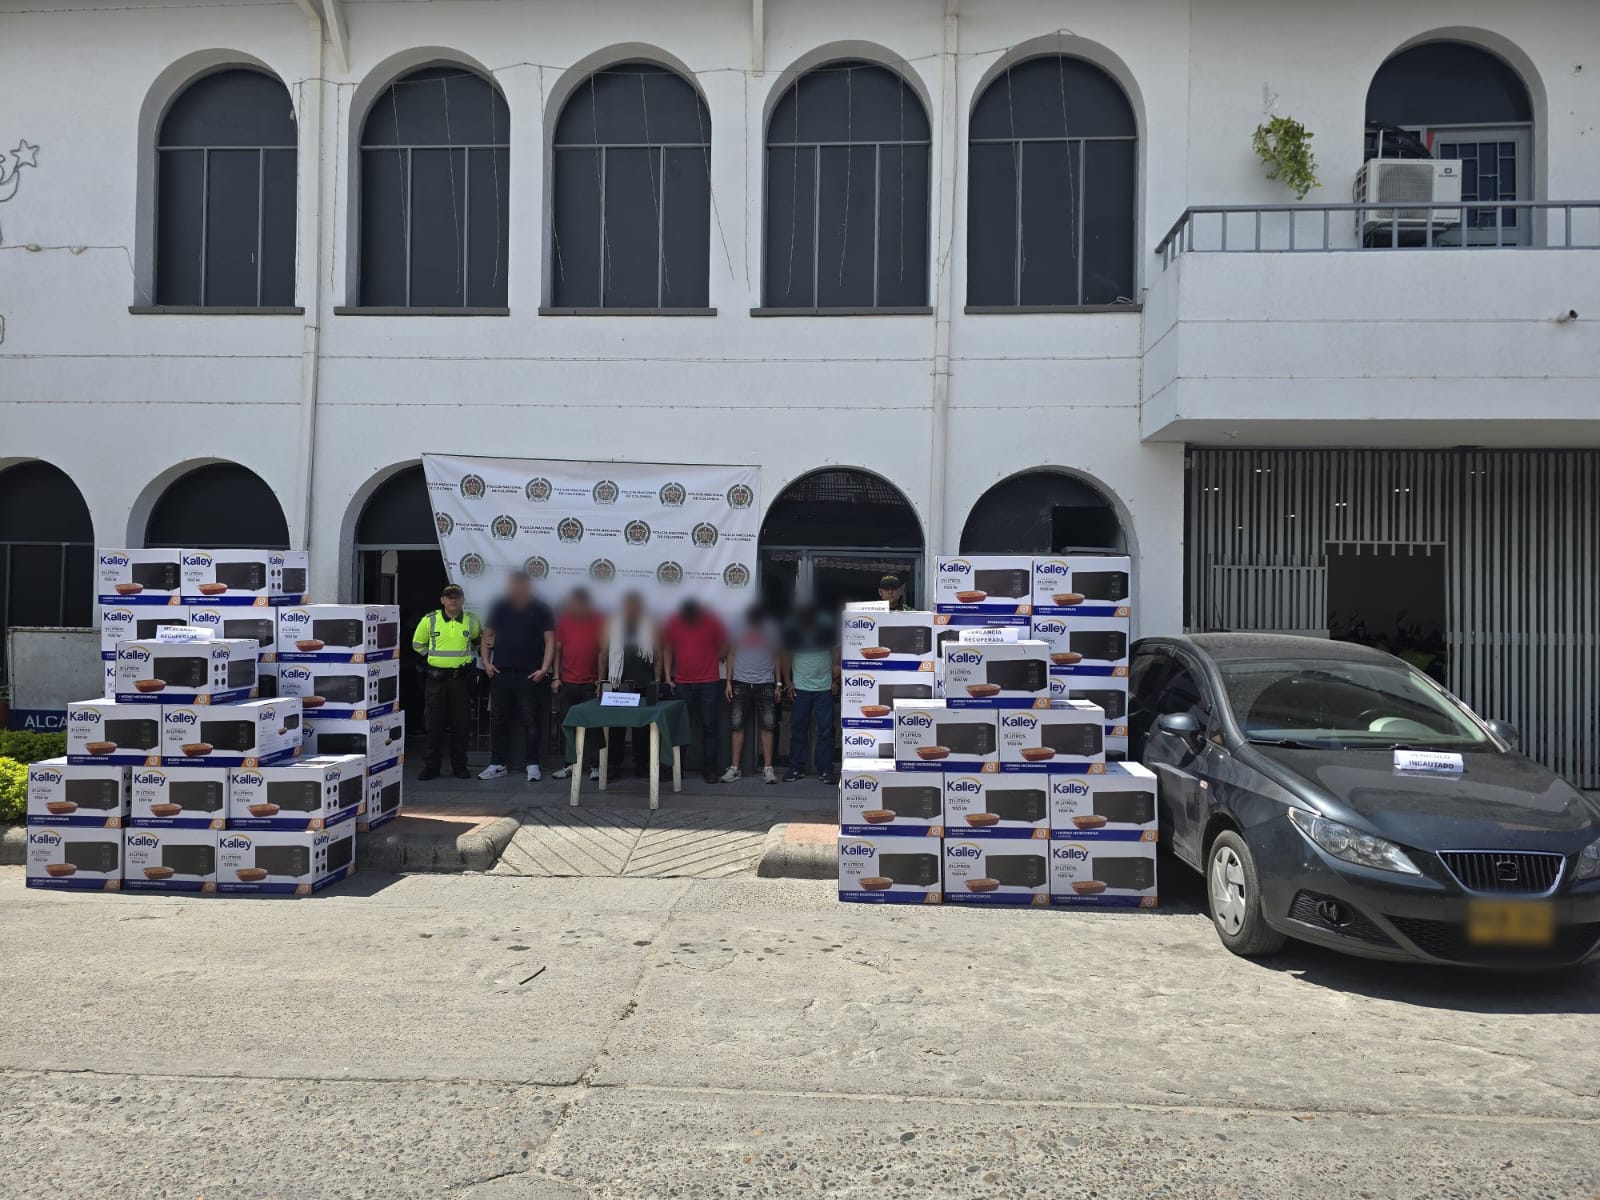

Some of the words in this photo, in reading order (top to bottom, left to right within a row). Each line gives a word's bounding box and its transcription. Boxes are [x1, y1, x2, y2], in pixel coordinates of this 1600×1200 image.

[101, 556, 129, 567] Kalley
[183, 557, 212, 567] Kalley
[269, 557, 284, 566] Kalley
[940, 563, 971, 574] Kalley
[1036, 565, 1069, 576] Kalley
[104, 612, 133, 623] Kalley
[192, 613, 220, 624] Kalley
[281, 613, 310, 624] Kalley
[366, 613, 379, 622] Kalley
[845, 620, 875, 631] Kalley
[1034, 623, 1066, 635] Kalley
[118, 650, 150, 662] Kalley
[212, 650, 230, 659] Kalley
[948, 653, 983, 665] Kalley
[281, 670, 310, 680] Kalley
[368, 669, 380, 677] Kalley
[845, 678, 875, 688] Kalley
[24, 714, 68, 728] ALCA
[70, 712, 101, 723] Kalley
[165, 713, 197, 725] Kalley
[260, 711, 275, 720] Kalley
[899, 716, 933, 728] Kalley
[1002, 717, 1037, 729] Kalley
[370, 725, 383, 734] Kalley
[845, 736, 875, 747] Kalley
[1409, 759, 1454, 769] INCAUTADO
[31, 772, 63, 784] Kalley
[134, 774, 166, 786] Kalley
[232, 775, 264, 786] Kalley
[325, 771, 341, 782] Kalley
[370, 779, 382, 790] Kalley
[845, 779, 878, 792] Kalley
[947, 781, 981, 794] Kalley
[1054, 784, 1089, 796] Kalley
[30, 834, 61, 846] Kalley
[128, 836, 159, 848] Kalley
[220, 839, 251, 850] Kalley
[314, 834, 329, 846] Kalley
[842, 845, 875, 858] Kalley
[947, 847, 982, 859] Kalley
[1053, 849, 1088, 861] Kalley
